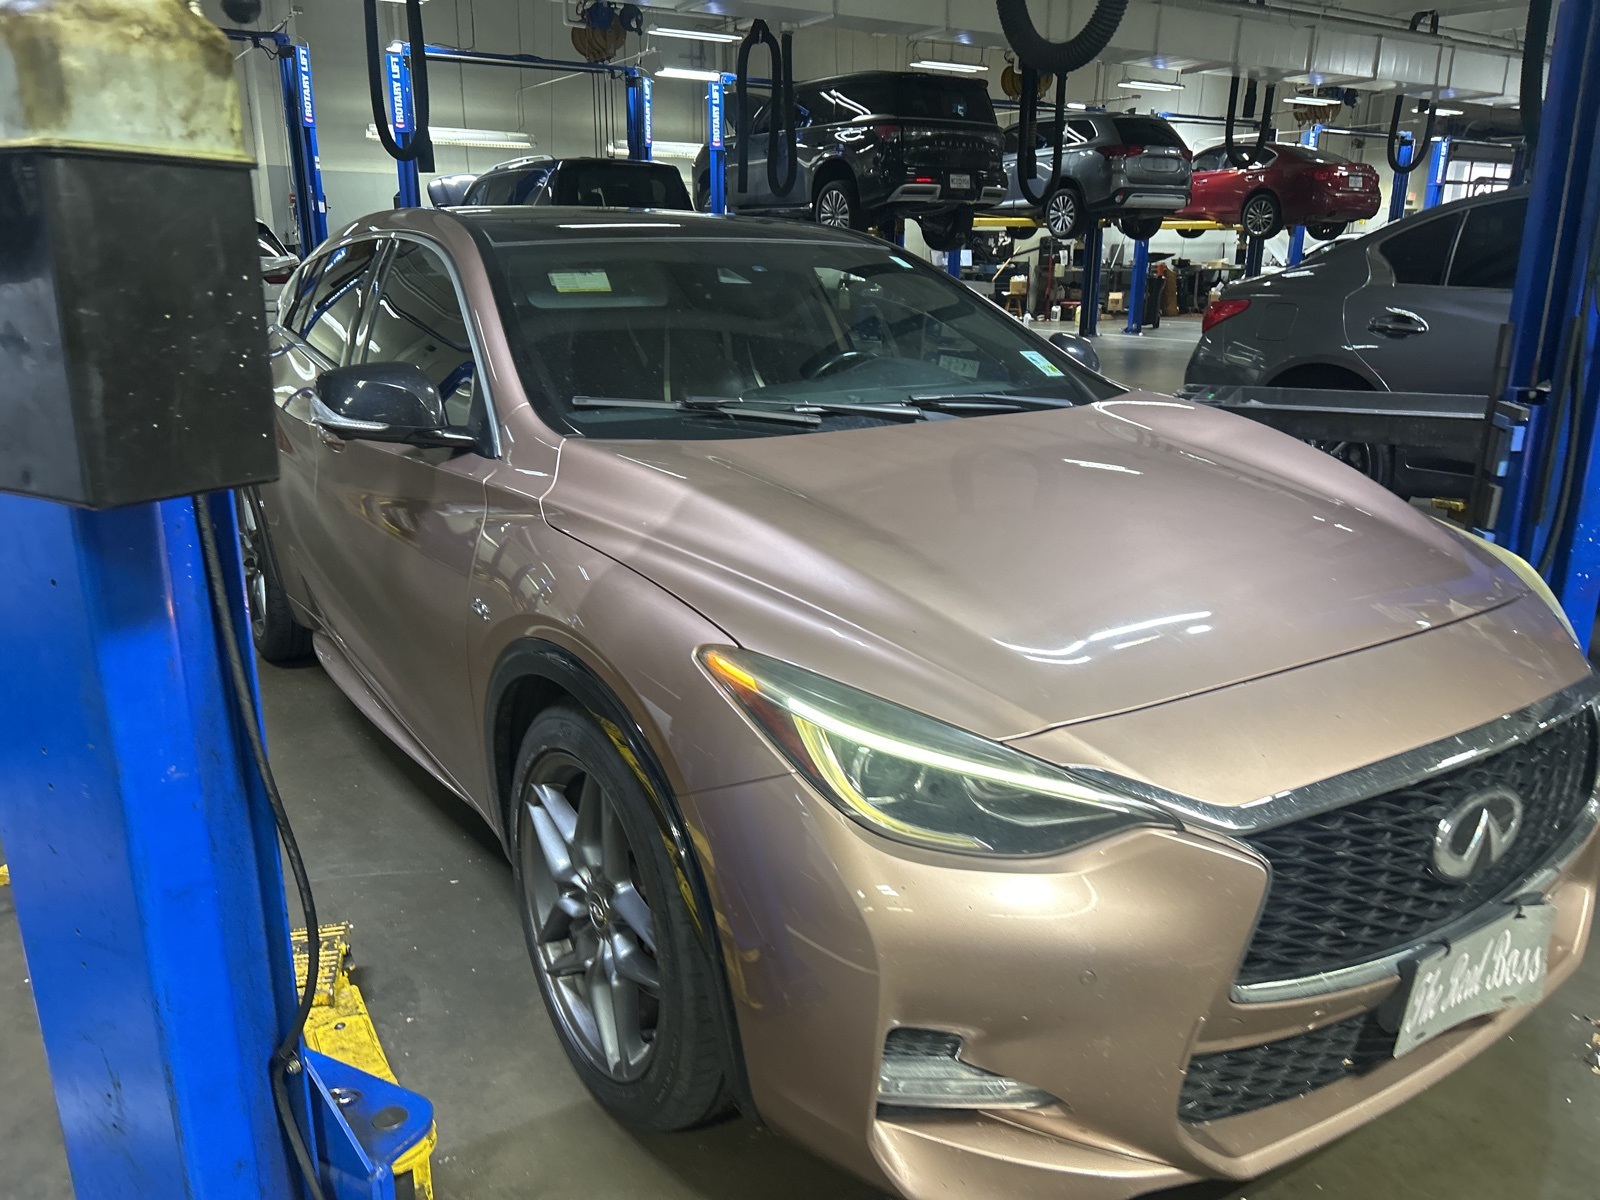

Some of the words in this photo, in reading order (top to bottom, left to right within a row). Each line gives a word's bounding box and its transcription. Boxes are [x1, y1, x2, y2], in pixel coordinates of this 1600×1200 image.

[300, 47, 308, 72] LIFT
[390, 56, 400, 79] LIFT
[302, 73, 312, 117] ROTARY
[393, 81, 404, 122] ROTARY
[712, 105, 720, 141] ROTARY
